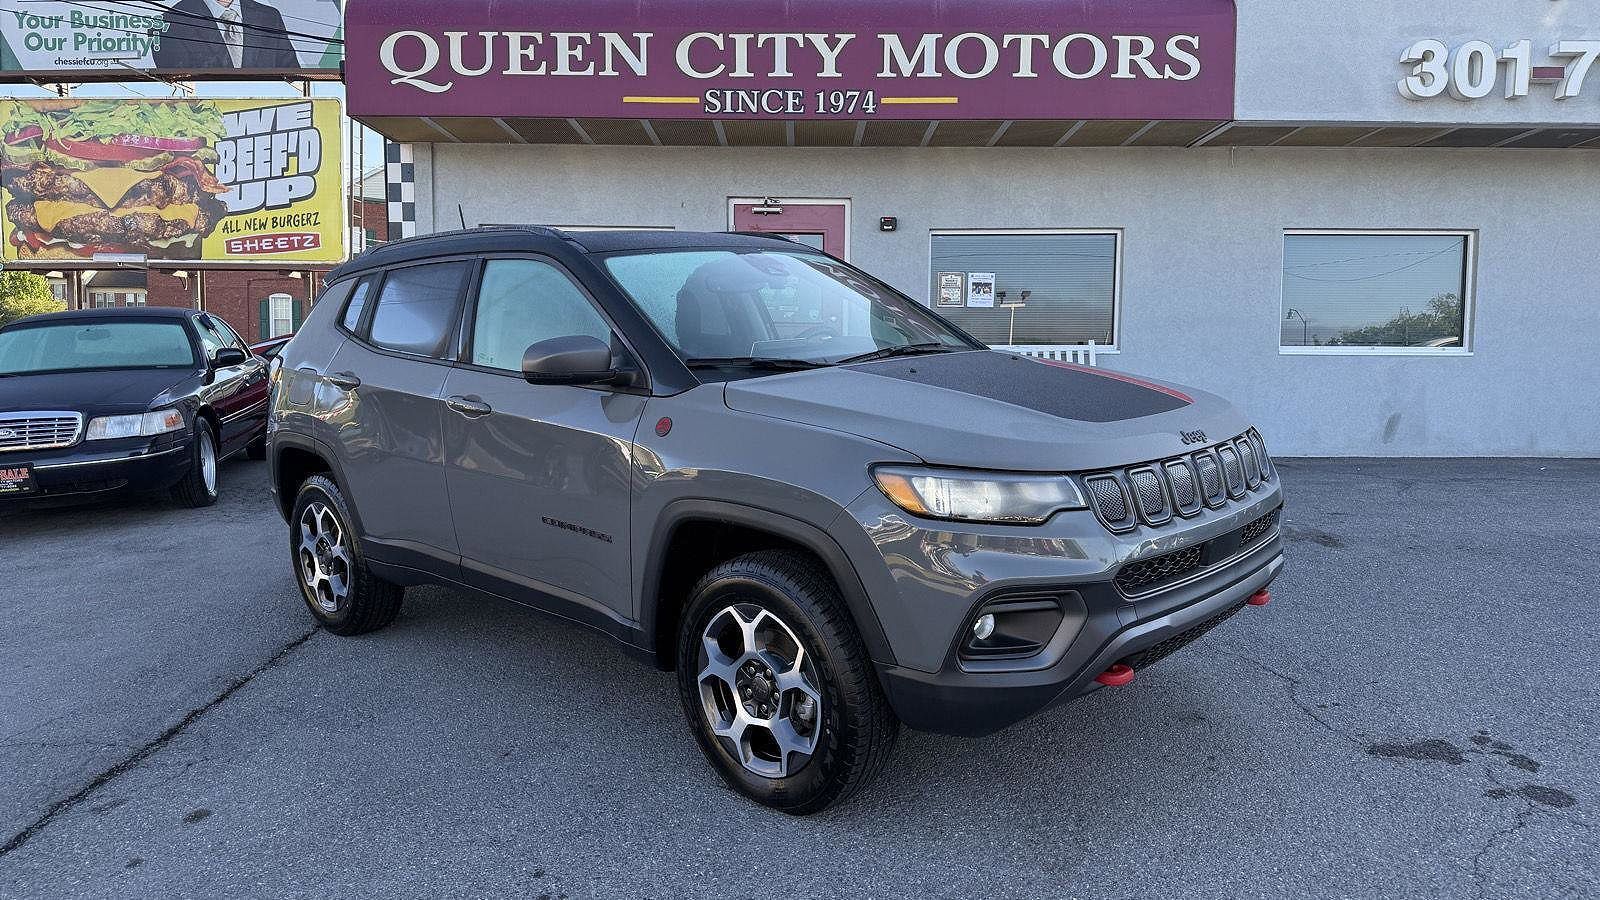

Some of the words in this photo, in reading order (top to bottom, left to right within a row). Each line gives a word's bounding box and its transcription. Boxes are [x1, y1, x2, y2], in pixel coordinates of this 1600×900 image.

[14, 10, 63, 29] Your
[70, 10, 170, 32] Business,
[24, 32, 67, 51] Our
[74, 32, 160, 56] Priority!
[379, 30, 653, 93] QUEEN
[675, 32, 856, 79] CITY
[876, 32, 1201, 81] MOTORS
[704, 89, 804, 113] SINCE
[815, 90, 877, 114] 1974
[222, 101, 313, 137] WE
[215, 127, 321, 184] BEEF'D
[216, 176, 316, 214] UP
[222, 220, 241, 234] ALL
[244, 217, 268, 232] NEW
[271, 212, 320, 229] BURGERZ
[230, 235, 315, 252] SHEETZ
[1180, 430, 1207, 445] Jeep
